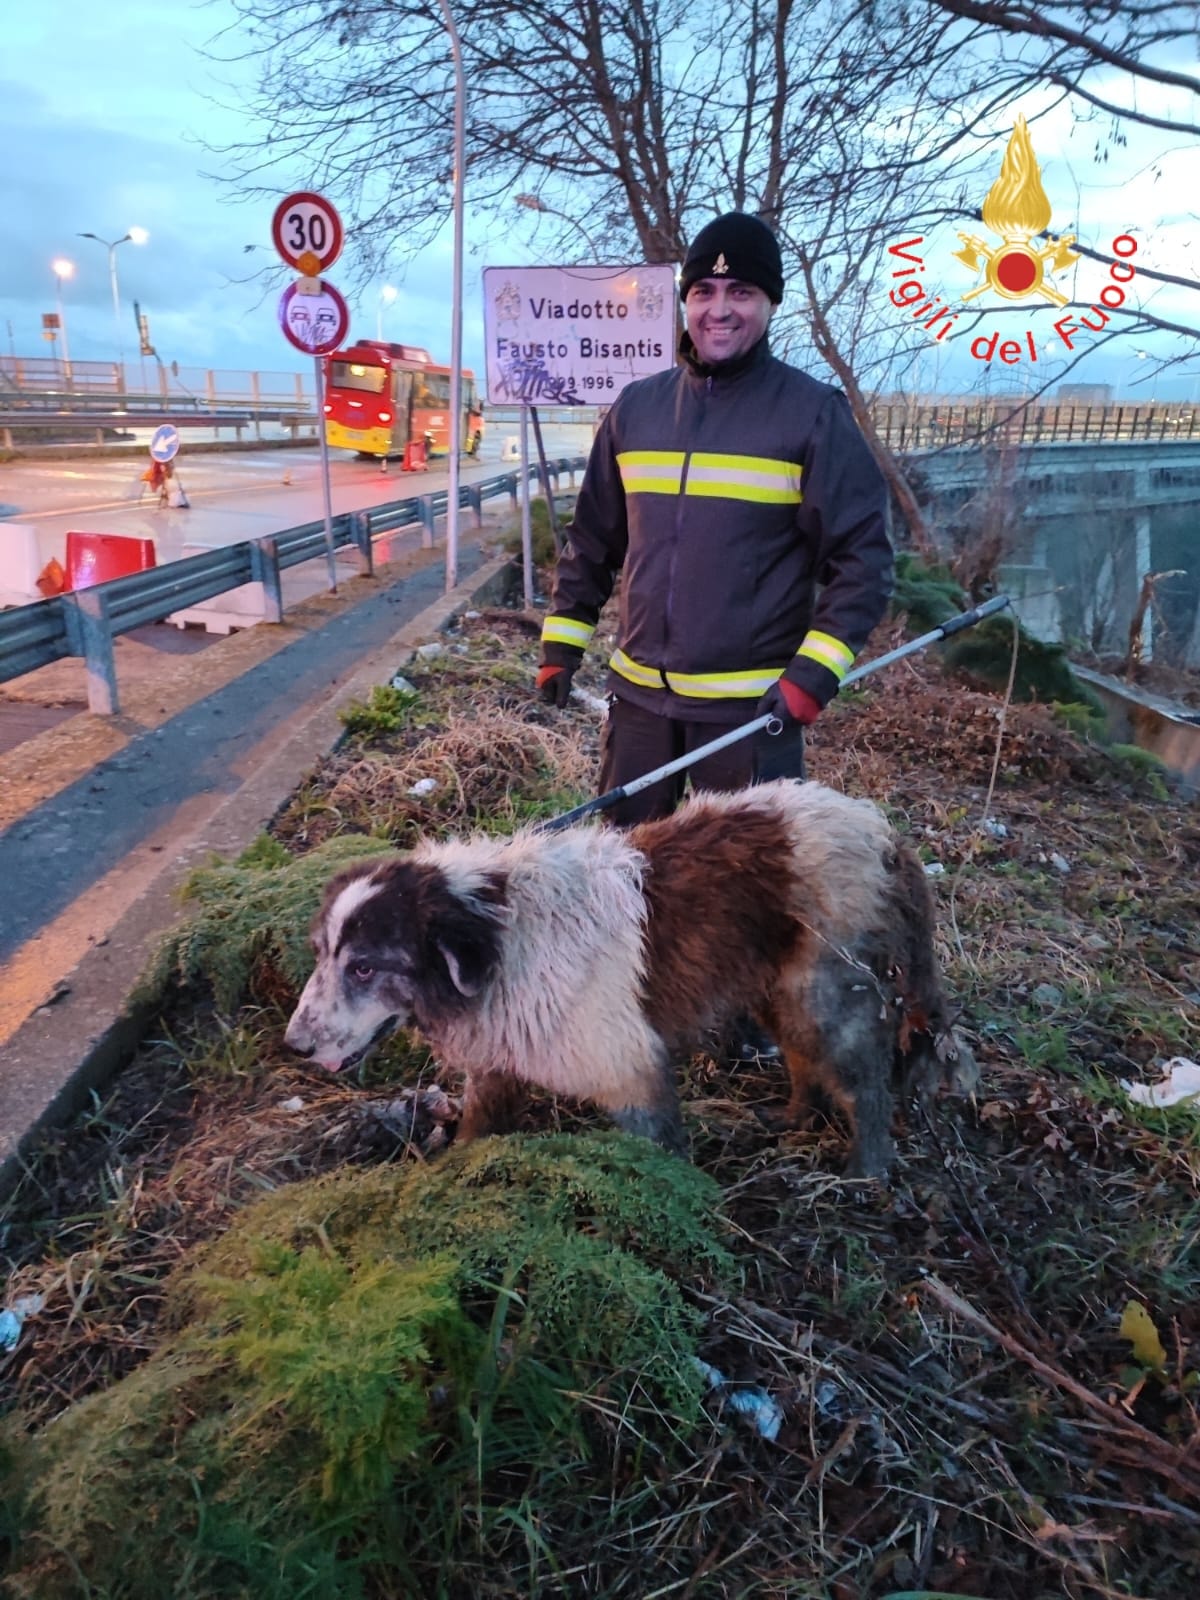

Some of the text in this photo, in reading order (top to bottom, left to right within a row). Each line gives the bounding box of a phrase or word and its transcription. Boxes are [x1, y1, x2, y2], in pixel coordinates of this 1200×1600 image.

[288, 213, 326, 251] 30
[529, 298, 629, 319] Viadotto
[496, 337, 663, 359] Fausto Bisantis
